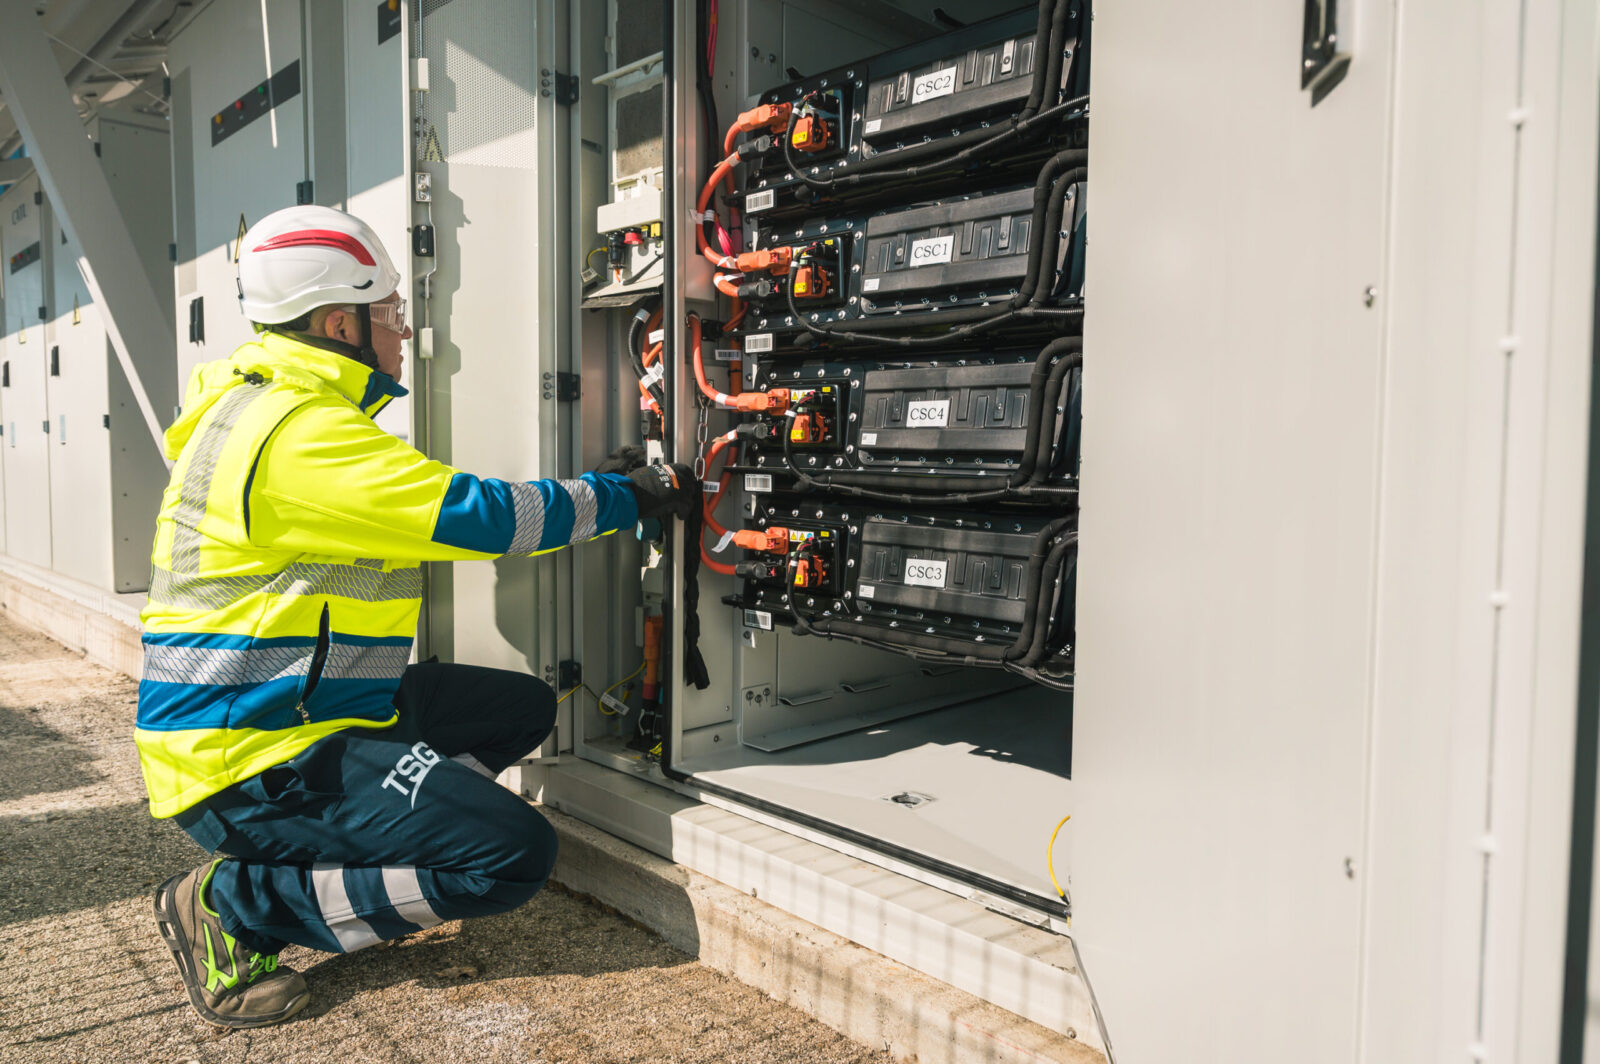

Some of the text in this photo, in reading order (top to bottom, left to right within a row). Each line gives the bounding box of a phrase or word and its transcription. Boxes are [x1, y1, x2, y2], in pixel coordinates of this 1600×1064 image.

[916, 75, 951, 96] CSC2
[914, 243, 948, 259] CSC1
[910, 407, 944, 421] CSC4
[907, 565, 942, 580] CSC3
[381, 741, 442, 797] TSG
